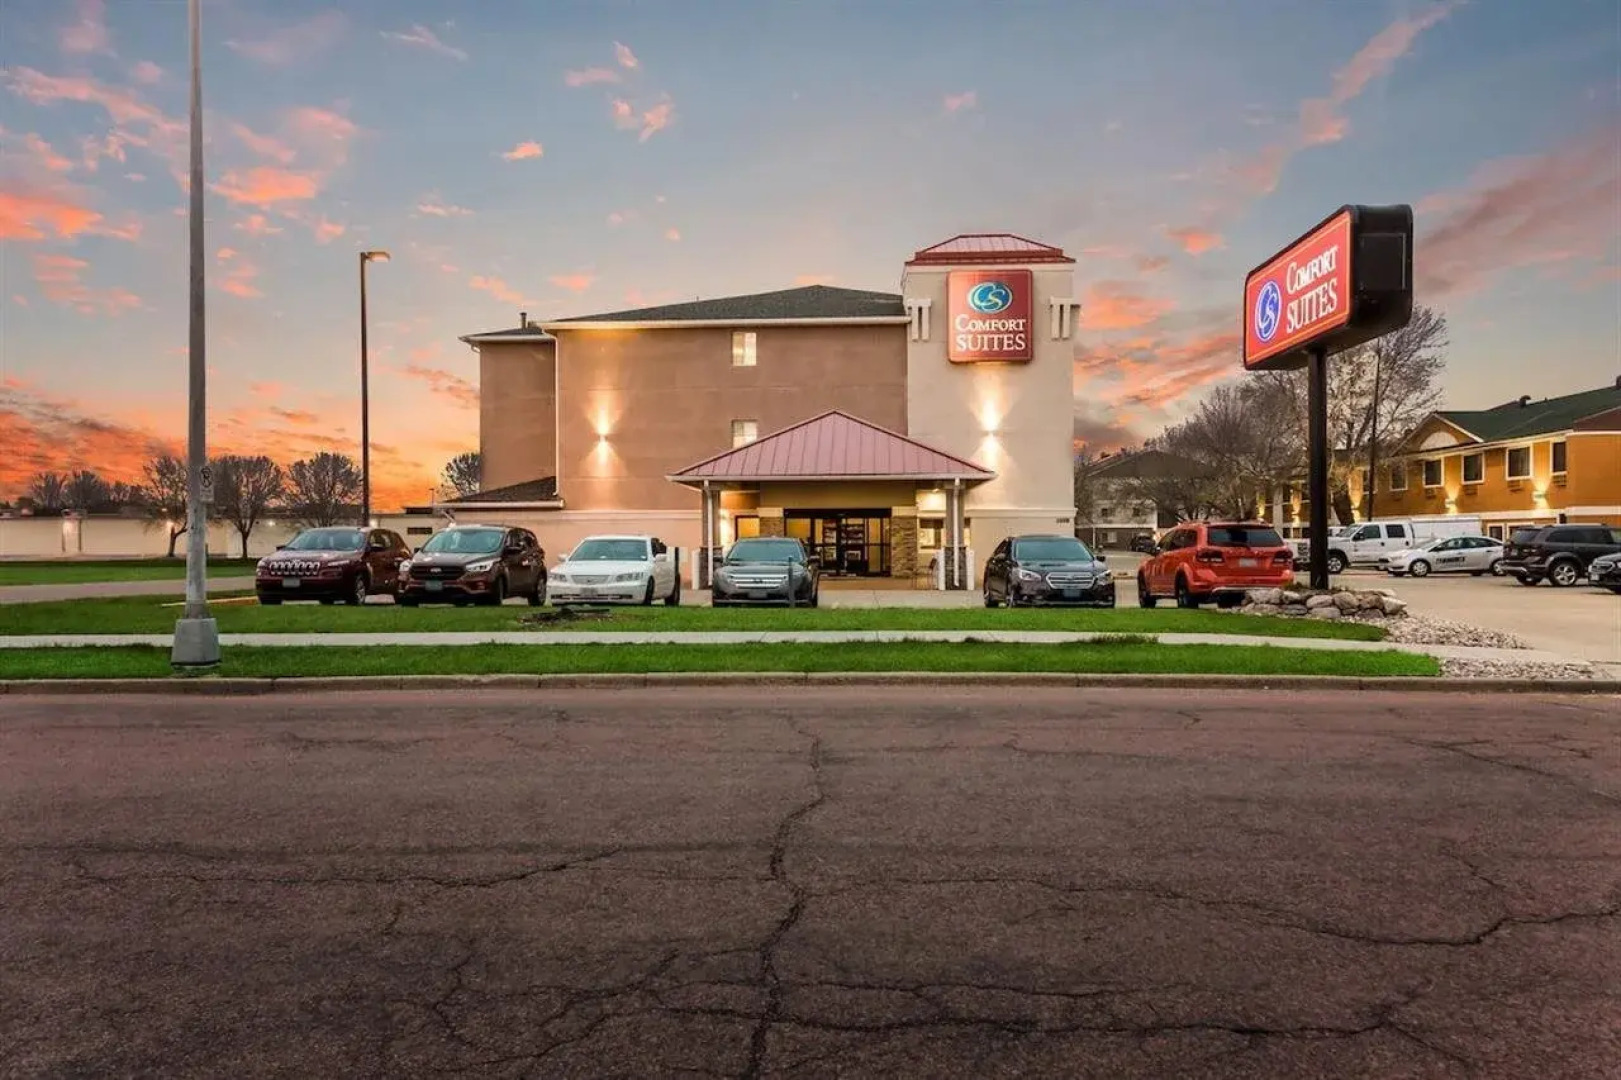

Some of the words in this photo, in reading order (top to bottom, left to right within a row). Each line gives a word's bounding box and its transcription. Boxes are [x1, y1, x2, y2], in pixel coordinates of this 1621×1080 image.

[1286, 244, 1339, 295] COMFORT
[955, 314, 1026, 332] COMFORT
[1286, 278, 1338, 334] SUITES
[955, 333, 1026, 352] SUITES
